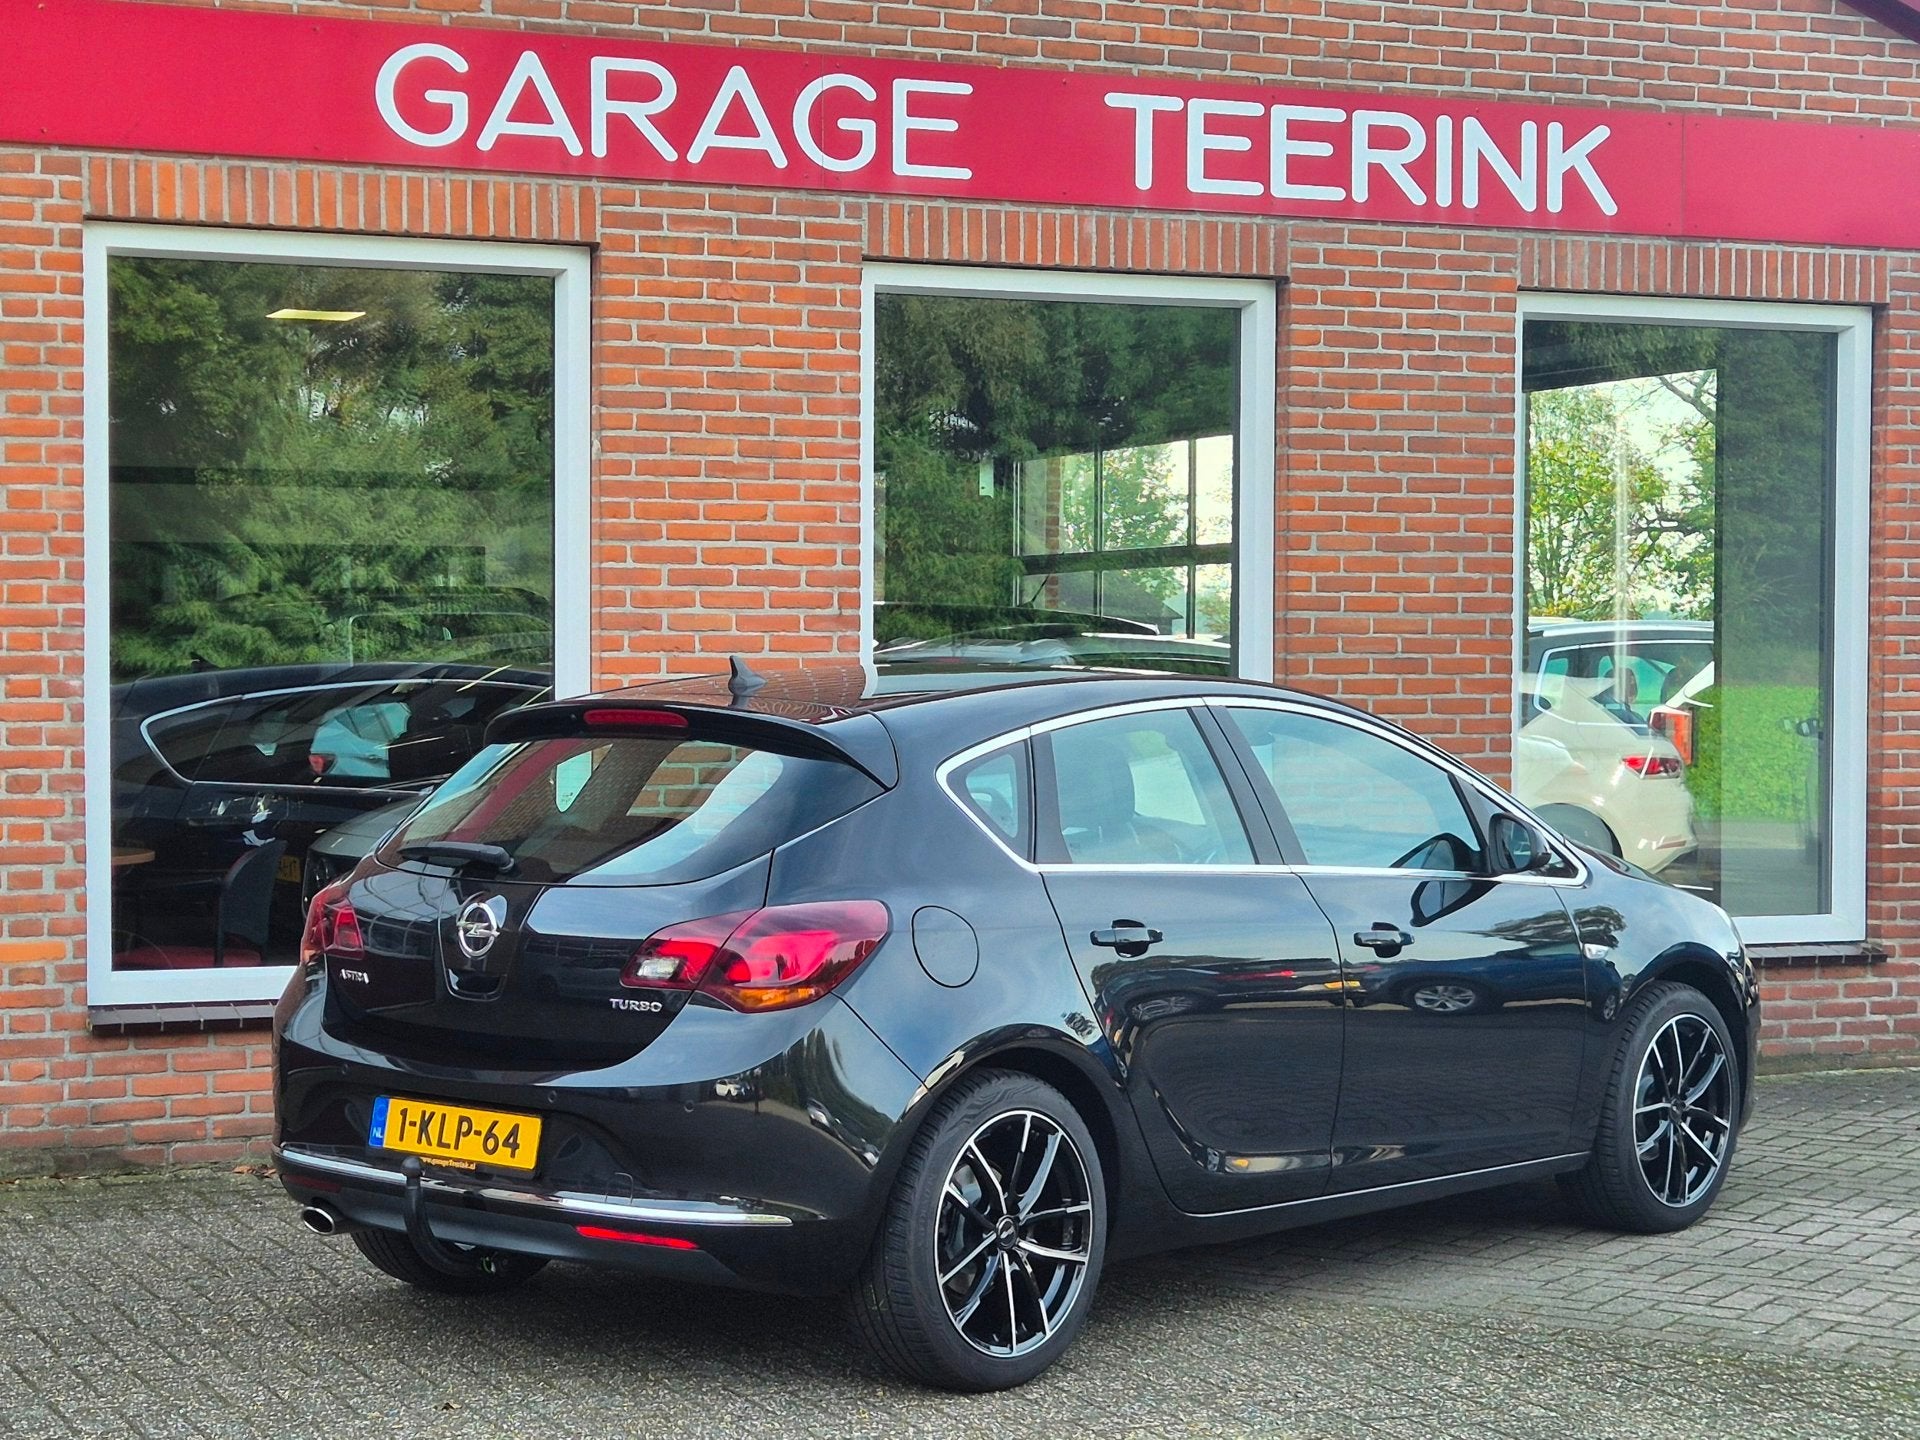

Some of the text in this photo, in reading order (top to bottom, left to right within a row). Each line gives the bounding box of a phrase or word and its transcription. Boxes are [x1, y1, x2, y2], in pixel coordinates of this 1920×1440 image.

[375, 43, 1618, 217] GARAGE TEERINK
[609, 998, 663, 1013] TURBO
[372, 1126, 384, 1139] NL
[398, 1107, 520, 1159] 1-KLP-64
